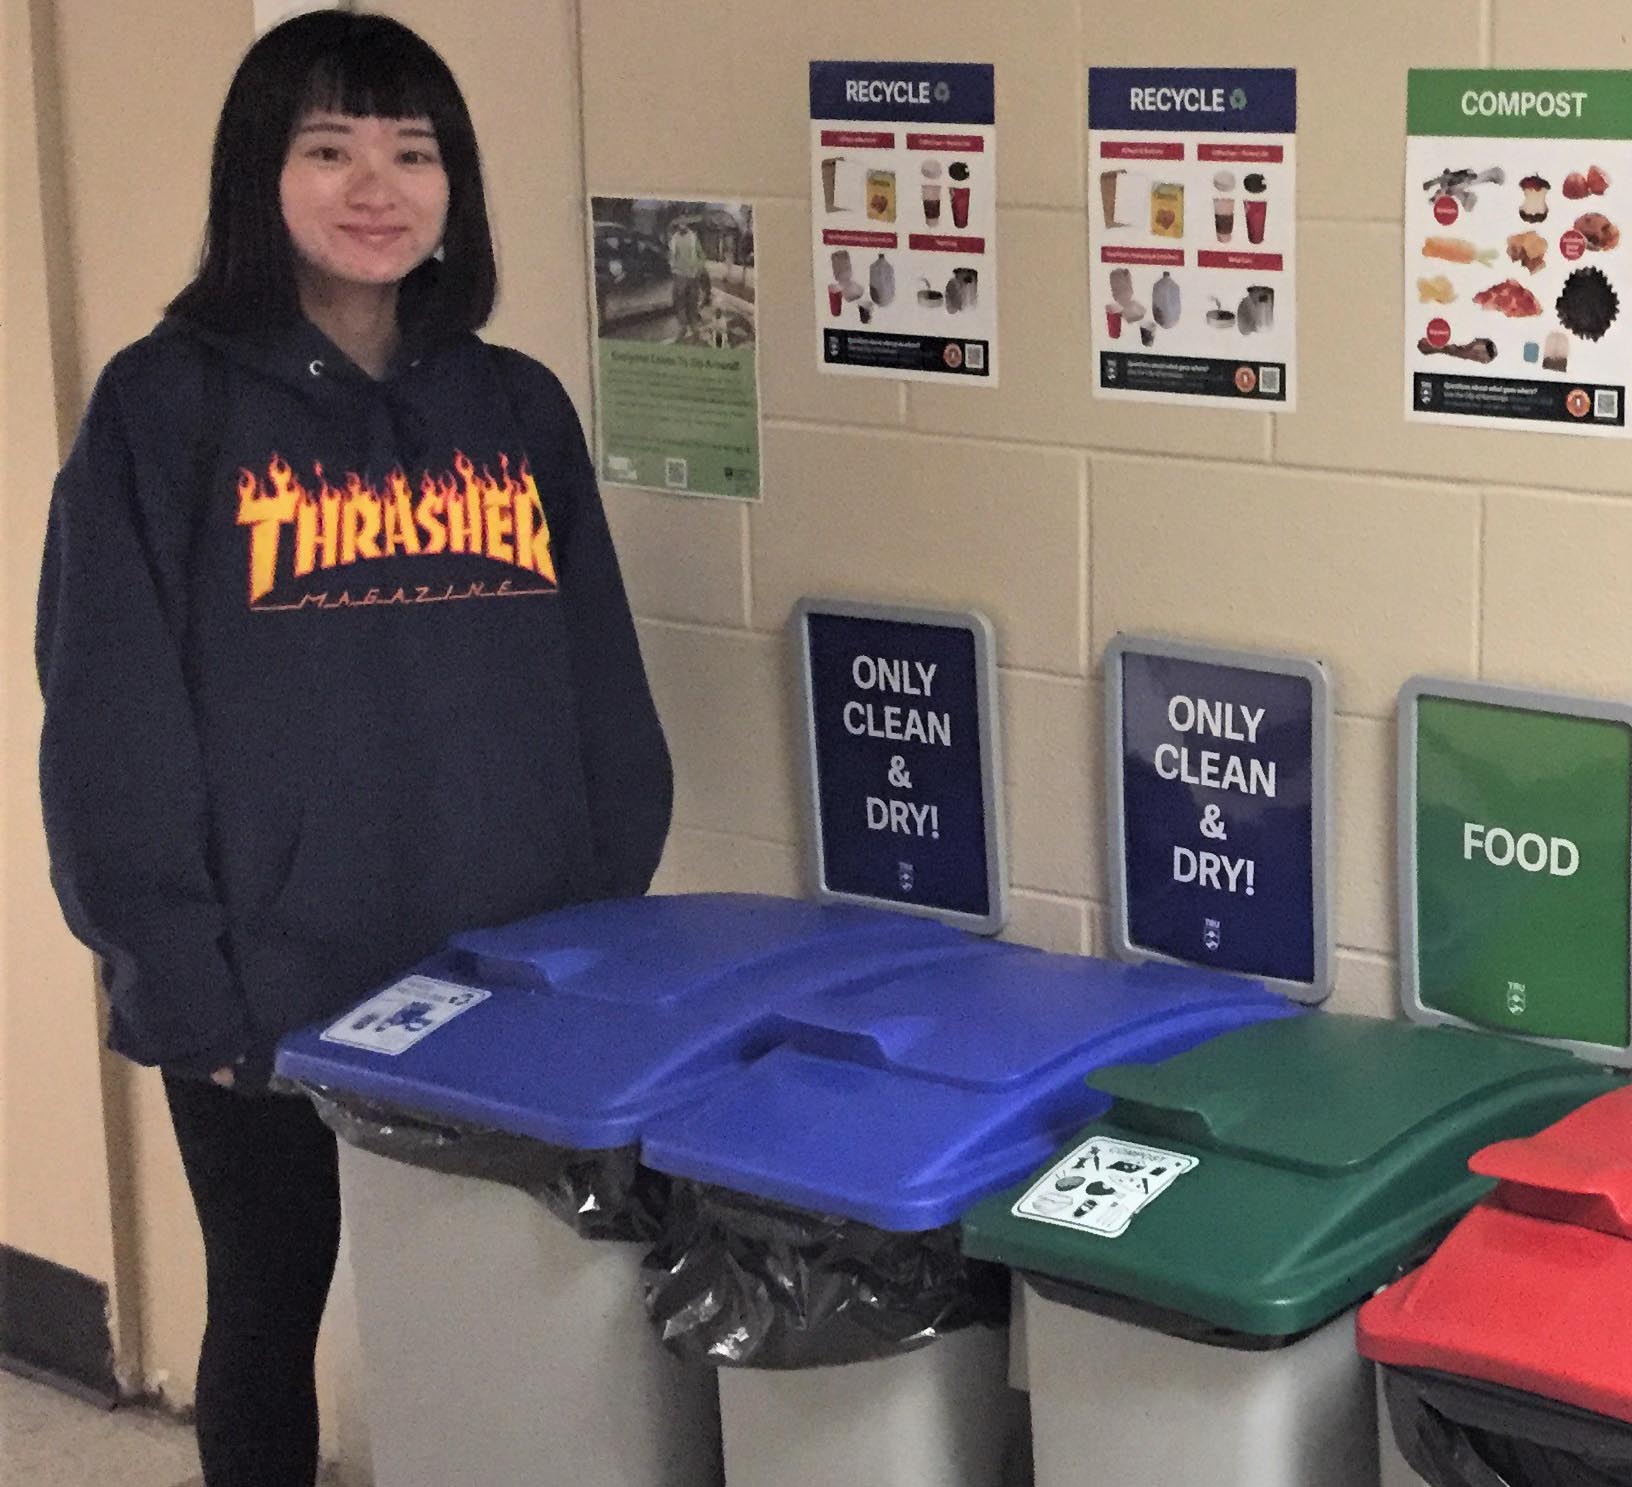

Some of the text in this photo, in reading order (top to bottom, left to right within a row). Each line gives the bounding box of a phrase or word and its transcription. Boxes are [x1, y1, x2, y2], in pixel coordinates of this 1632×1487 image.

[846, 80, 930, 103] RECYCLE
[1130, 87, 1225, 112] RECYCLE
[1461, 90, 1588, 117] COMPOST
[235, 449, 557, 603] THRASHER
[301, 580, 513, 609] MAGAZINE
[852, 654, 937, 697] ONLY
[843, 700, 951, 747] CLEAN
[1168, 695, 1265, 743] ONLY
[887, 755, 913, 789] &
[1154, 743, 1276, 798] CLEAN
[866, 796, 939, 840] DRY!
[1199, 803, 1227, 840] &
[1173, 845, 1255, 896] DRY!
[1463, 822, 1580, 877] FOOD
[1507, 981, 1526, 993] TRU
